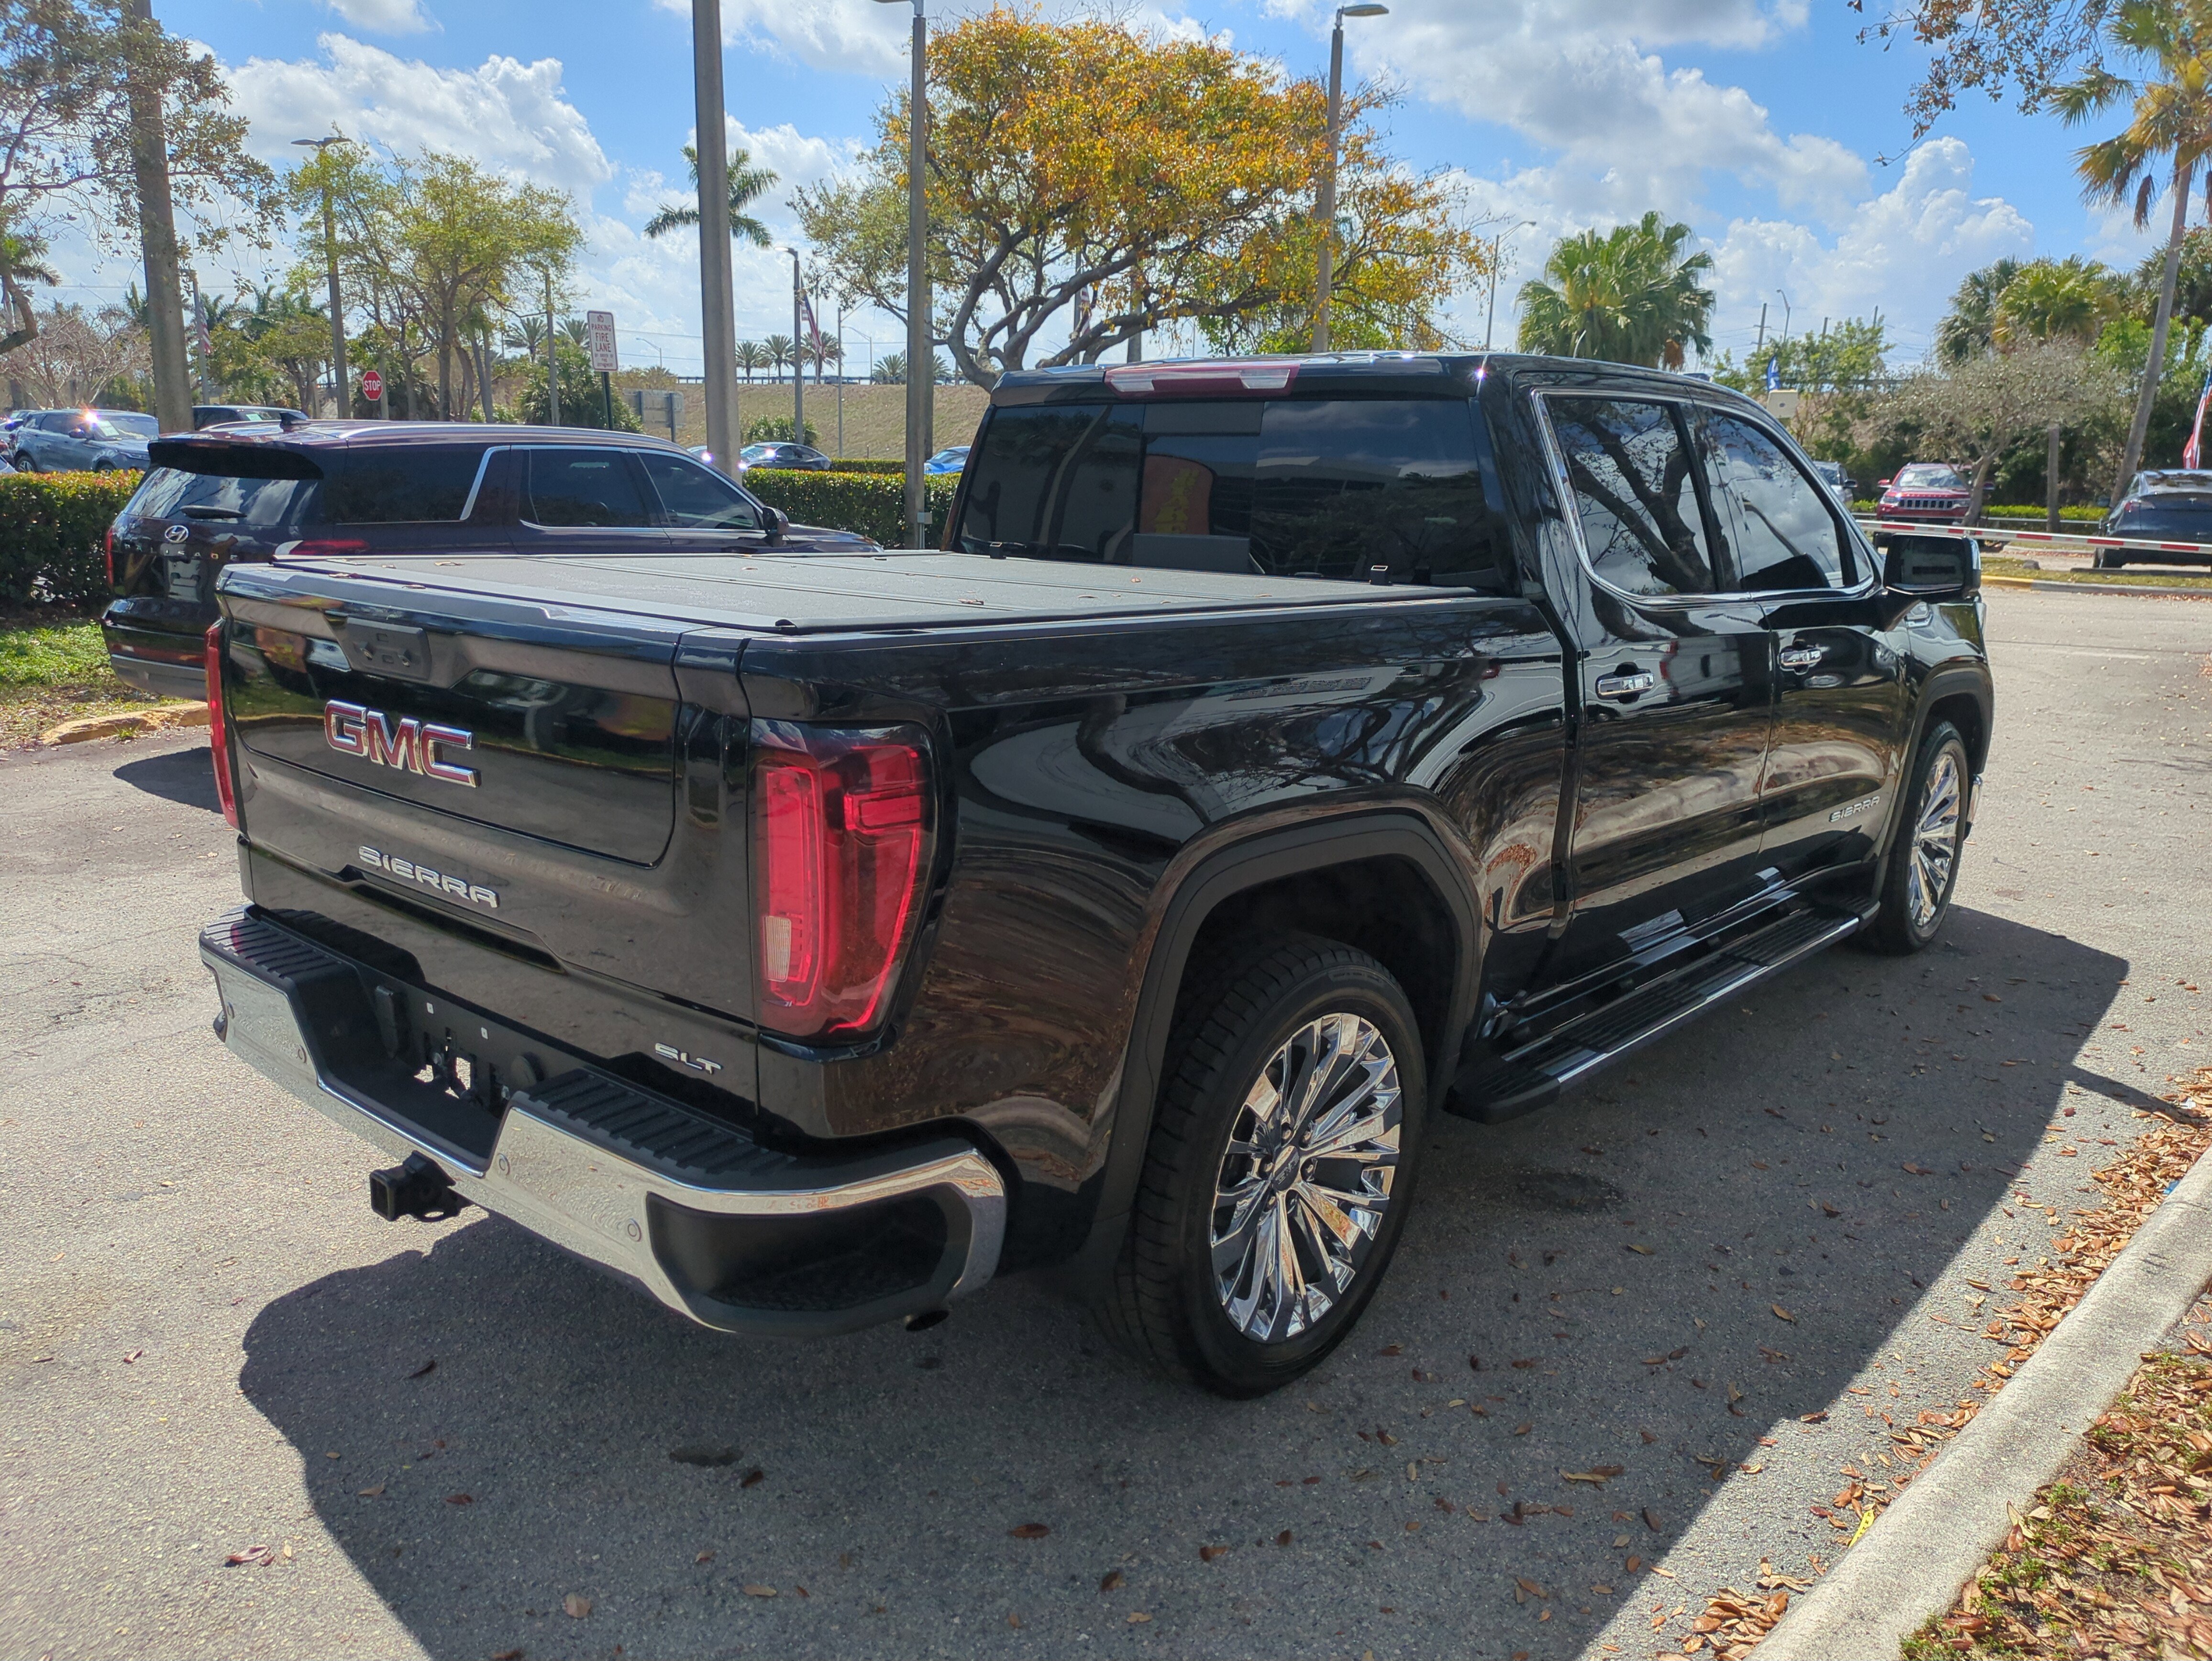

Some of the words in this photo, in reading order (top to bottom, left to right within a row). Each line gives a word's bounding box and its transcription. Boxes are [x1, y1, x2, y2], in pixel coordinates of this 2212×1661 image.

[591, 323, 611, 332] PARKING
[596, 332, 609, 342] FIRE
[596, 343, 611, 352] LANE
[365, 380, 381, 391] STOP
[324, 699, 478, 788] GMC
[1829, 796, 1880, 823] SIERRA
[358, 846, 500, 908] SIERRA
[655, 1043, 721, 1074] SLT
